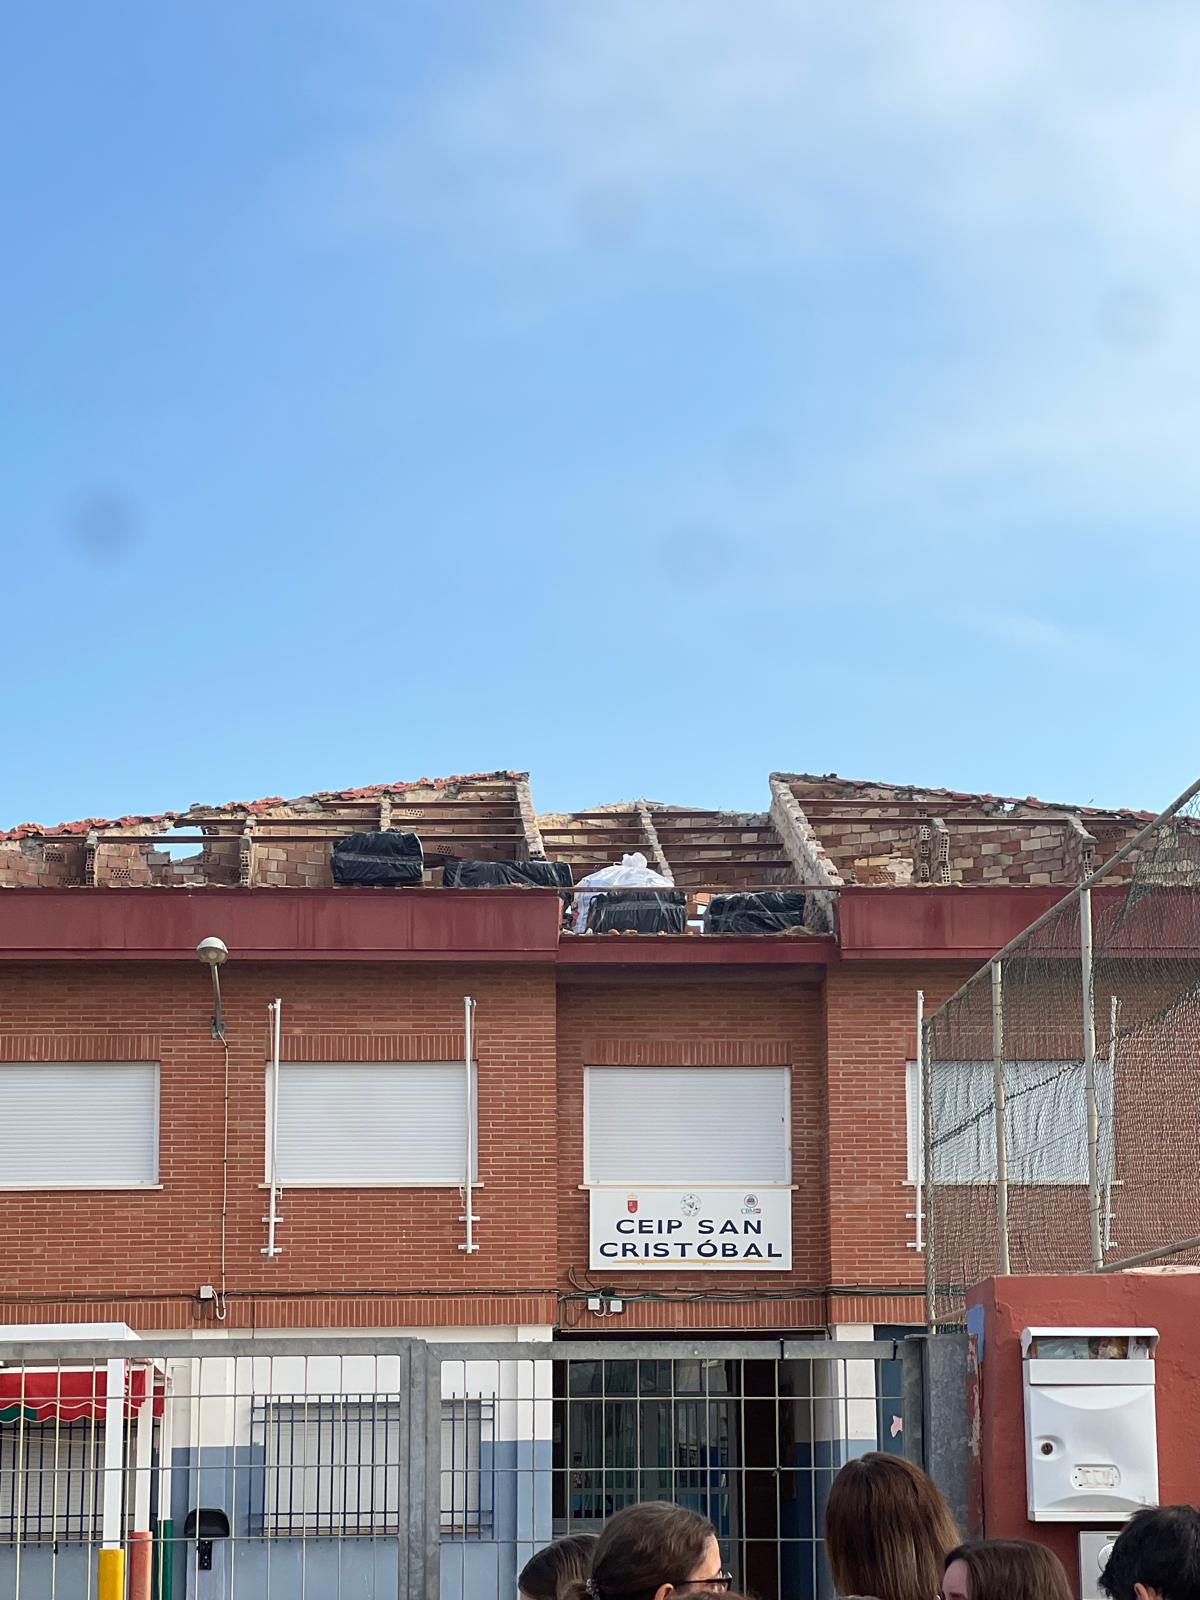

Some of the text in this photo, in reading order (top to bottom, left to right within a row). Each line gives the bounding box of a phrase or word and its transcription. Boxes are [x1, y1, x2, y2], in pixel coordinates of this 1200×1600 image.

[616, 1219, 762, 1235] CEIP SAN
[599, 1240, 783, 1258] CRISTÓBAL
